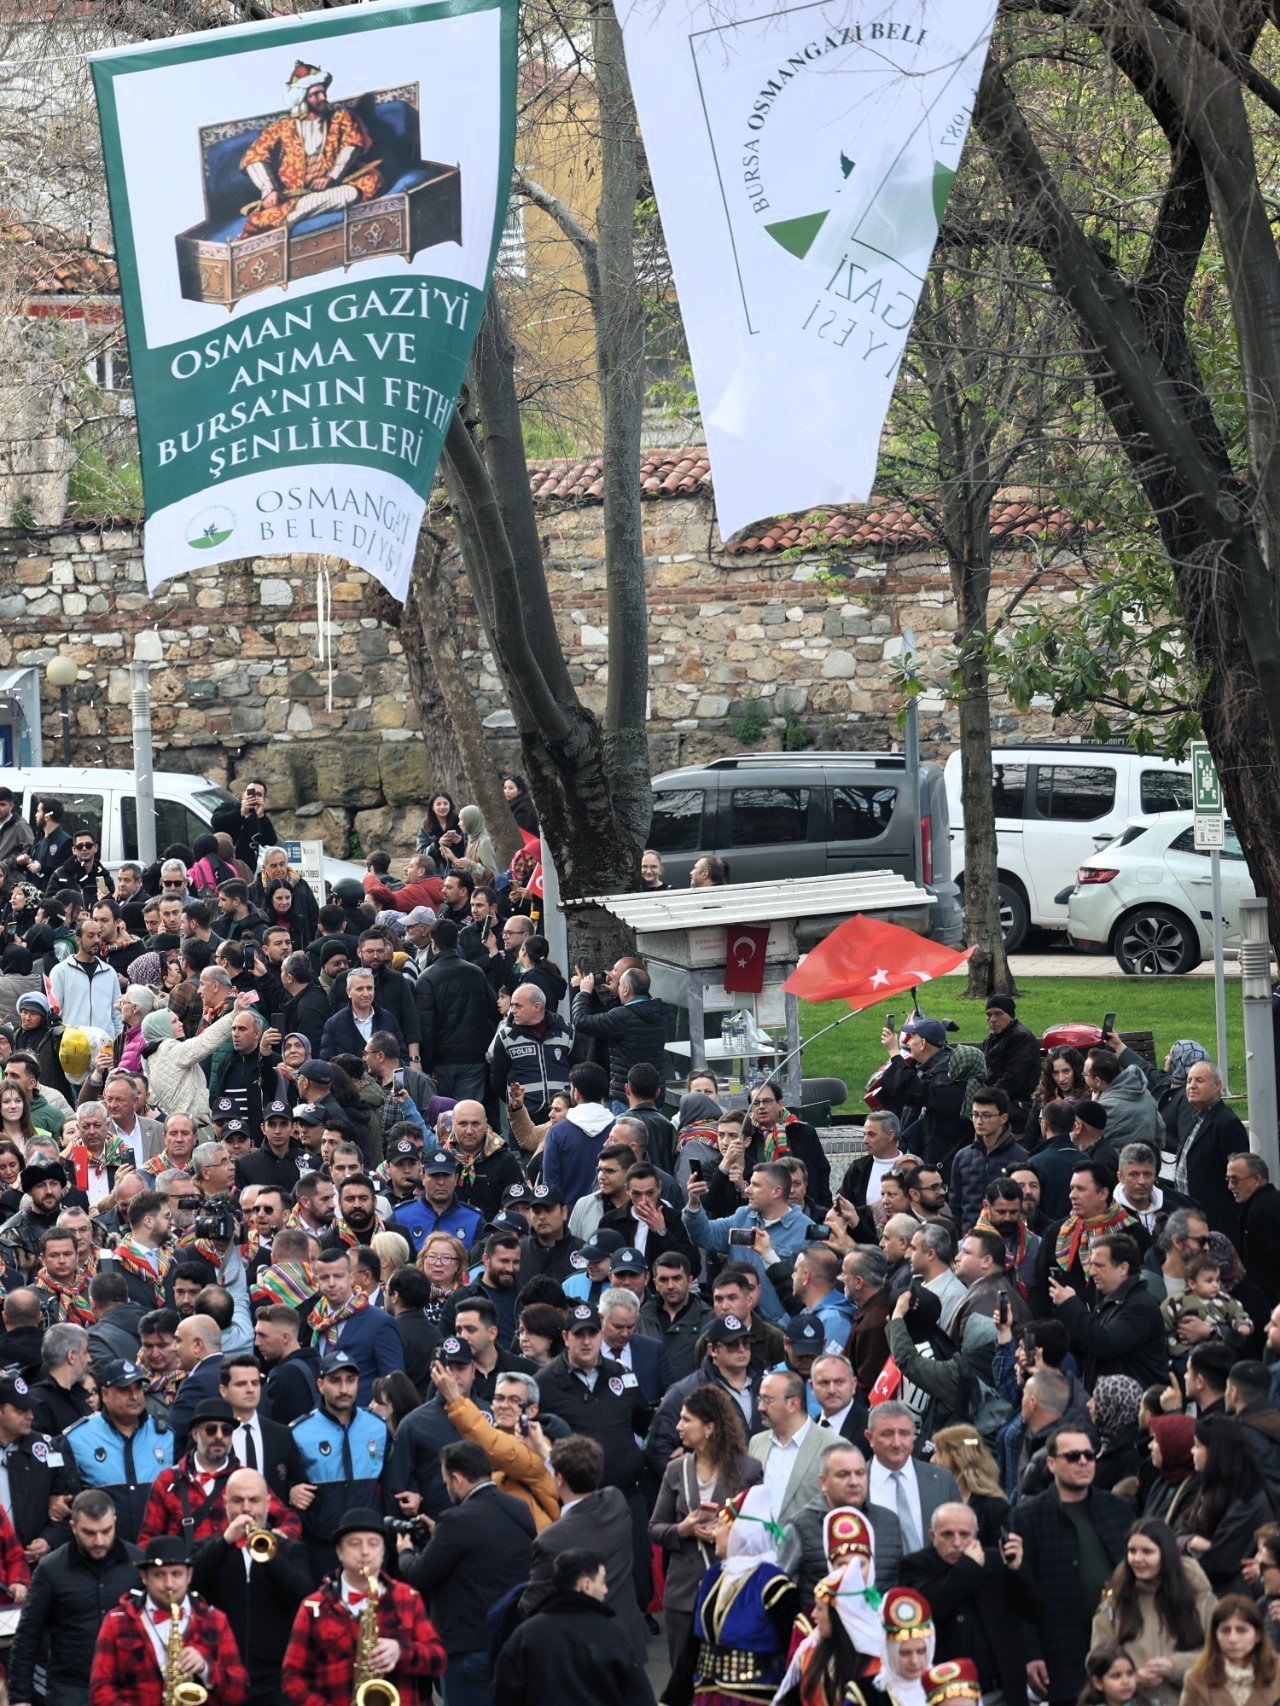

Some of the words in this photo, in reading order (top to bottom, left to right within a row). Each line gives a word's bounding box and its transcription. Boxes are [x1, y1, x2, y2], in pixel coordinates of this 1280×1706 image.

[747, 21, 862, 131] OSMANGAZİ
[742, 137, 770, 214] BURSA
[170, 304, 313, 379] OSMAN
[327, 282, 470, 331] GAZİ'Yİ
[227, 337, 358, 394] ANMA
[362, 332, 416, 364] VE
[156, 376, 366, 467] BURSA'NIN
[382, 376, 456, 434] FETHİ
[209, 417, 424, 479] ŞENLİKLERİ
